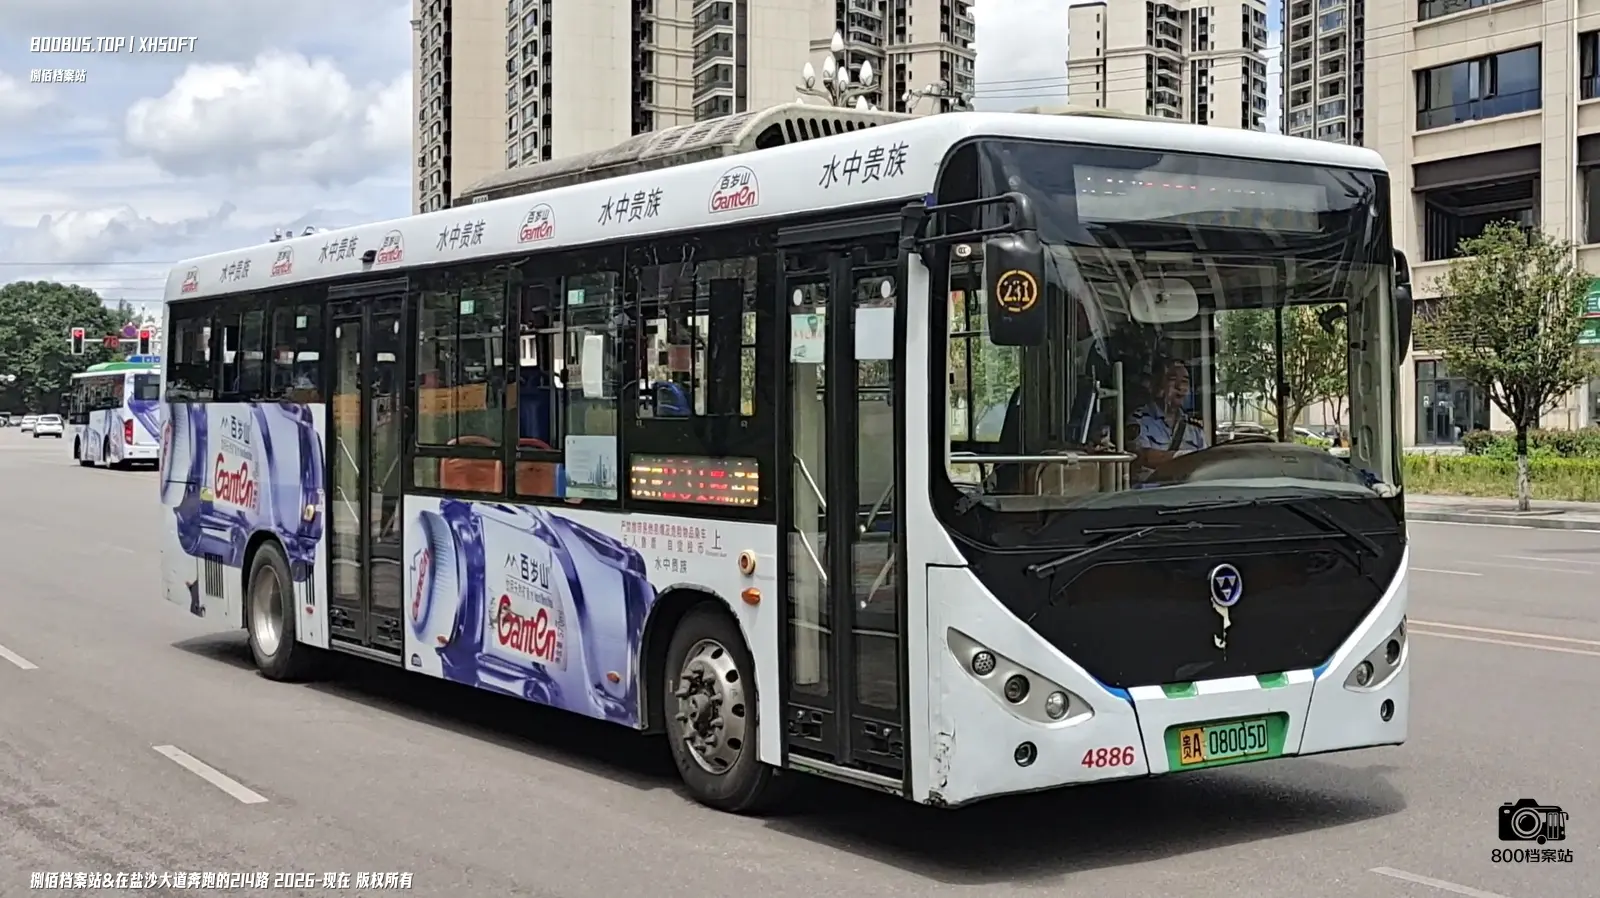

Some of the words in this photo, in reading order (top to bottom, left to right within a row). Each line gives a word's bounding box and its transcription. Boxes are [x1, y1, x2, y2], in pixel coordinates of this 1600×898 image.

[820, 140, 910, 189] 水中贵族
[720, 172, 750, 190] 百岁山
[598, 187, 663, 226] 水中贵族
[318, 235, 359, 264] 水中贵族
[436, 219, 486, 251] 水中贵族
[711, 529, 722, 550] 上
[520, 552, 549, 590] 百岁山
[654, 557, 687, 574] 水中贵族
[498, 594, 557, 662] Ganten
[1208, 724, 1267, 755] 08005D
[1081, 746, 1135, 768] 4886
